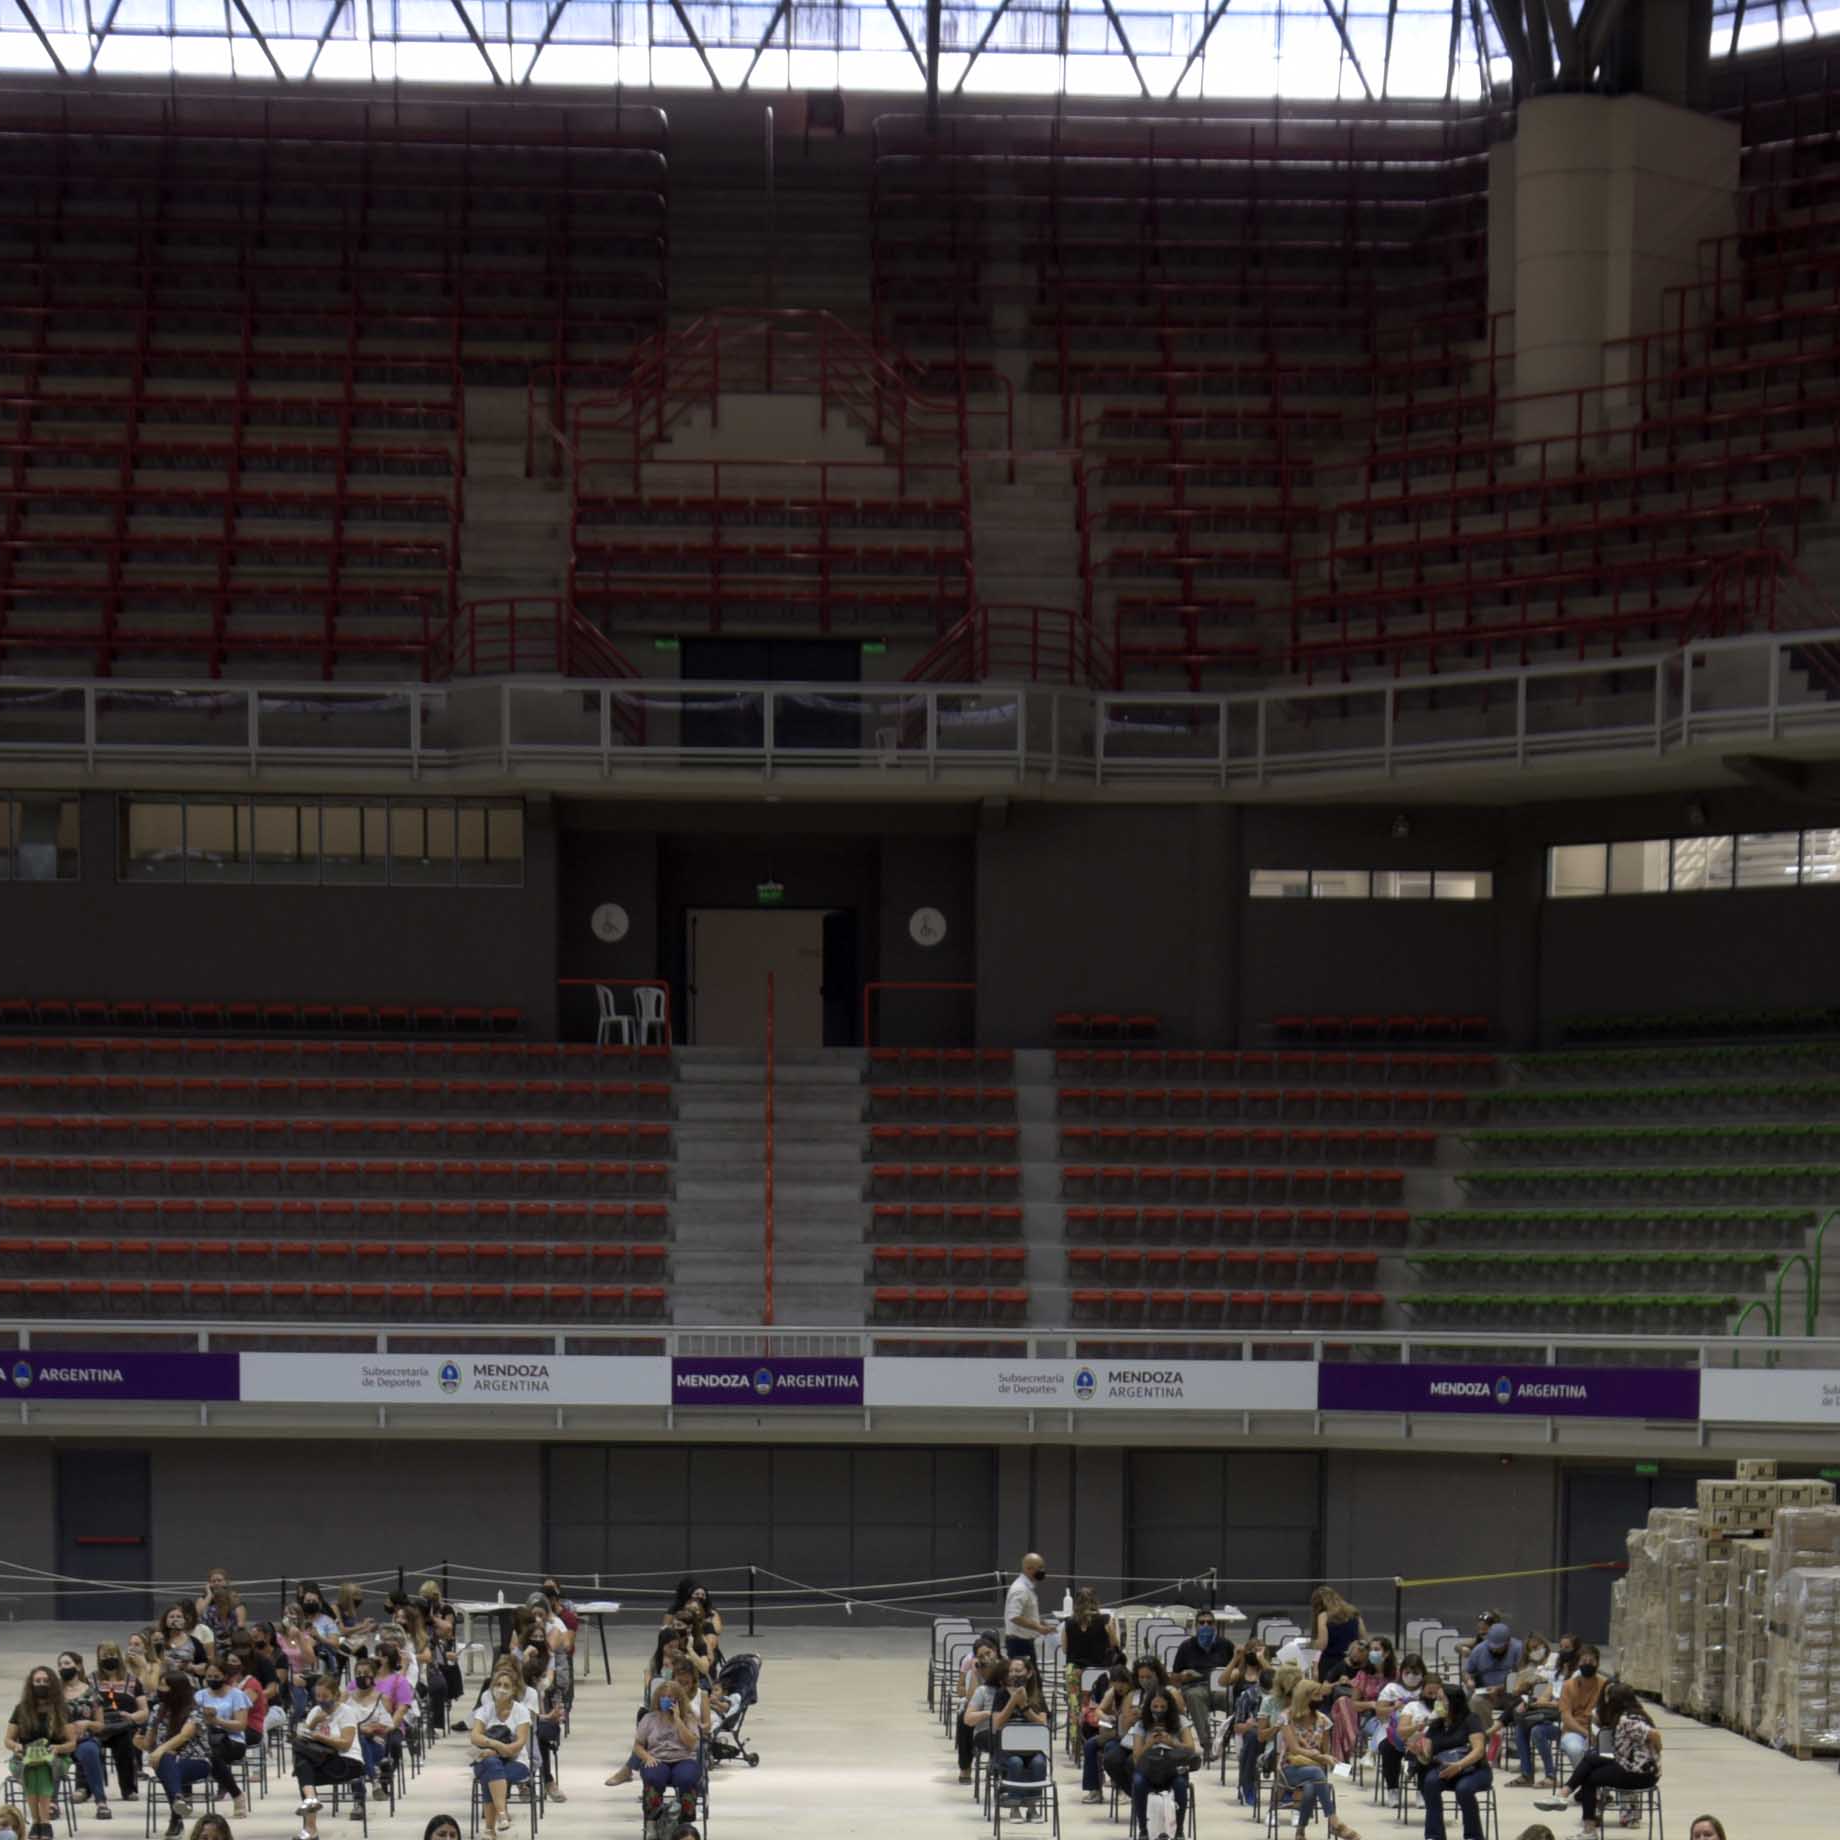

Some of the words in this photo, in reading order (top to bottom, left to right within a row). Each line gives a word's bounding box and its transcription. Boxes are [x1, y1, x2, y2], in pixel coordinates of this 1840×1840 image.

[39, 1368, 124, 1382] ARGENTINA
[473, 1364, 549, 1377] MENDOZA
[361, 1377, 373, 1387] de
[376, 1377, 422, 1388] Deportes
[676, 1373, 750, 1387] MENDOZA
[776, 1374, 859, 1388] ARGENTINA
[1108, 1371, 1183, 1384] MENDOZA
[474, 1379, 549, 1392] ARGENTINA
[998, 1384, 1010, 1394] de
[1013, 1384, 1057, 1396] Deportes
[1430, 1381, 1490, 1396] MENDOZA
[1517, 1383, 1587, 1399] ARGENTINA
[1109, 1386, 1183, 1399] ARGENTINA
[1822, 1396, 1833, 1406] de
